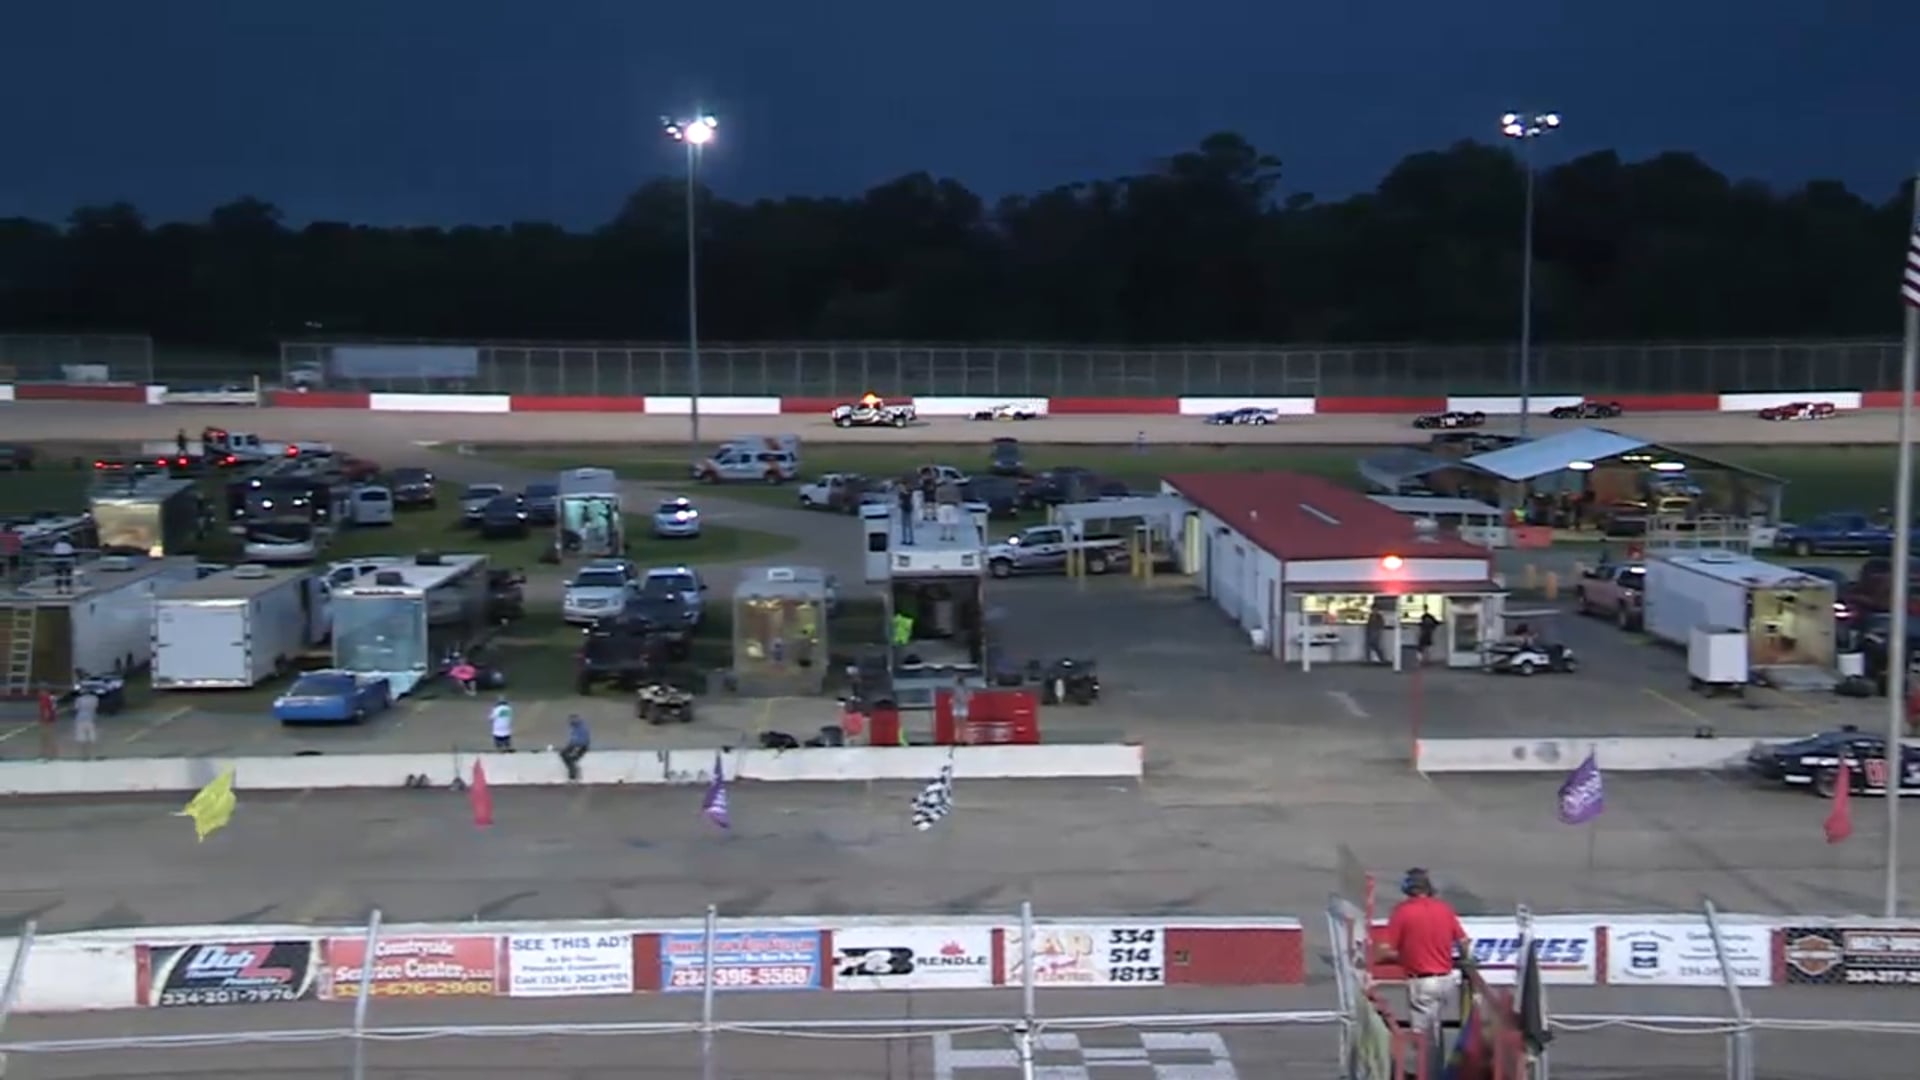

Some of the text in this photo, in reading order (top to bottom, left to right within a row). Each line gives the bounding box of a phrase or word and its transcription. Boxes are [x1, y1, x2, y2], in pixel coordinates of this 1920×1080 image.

[512, 938, 544, 951] SEE
[551, 936, 591, 949] THIS
[1109, 929, 1155, 944] 334
[1109, 948, 1151, 963] 514
[335, 964, 402, 981] Sevice
[1109, 966, 1161, 981] 1813
